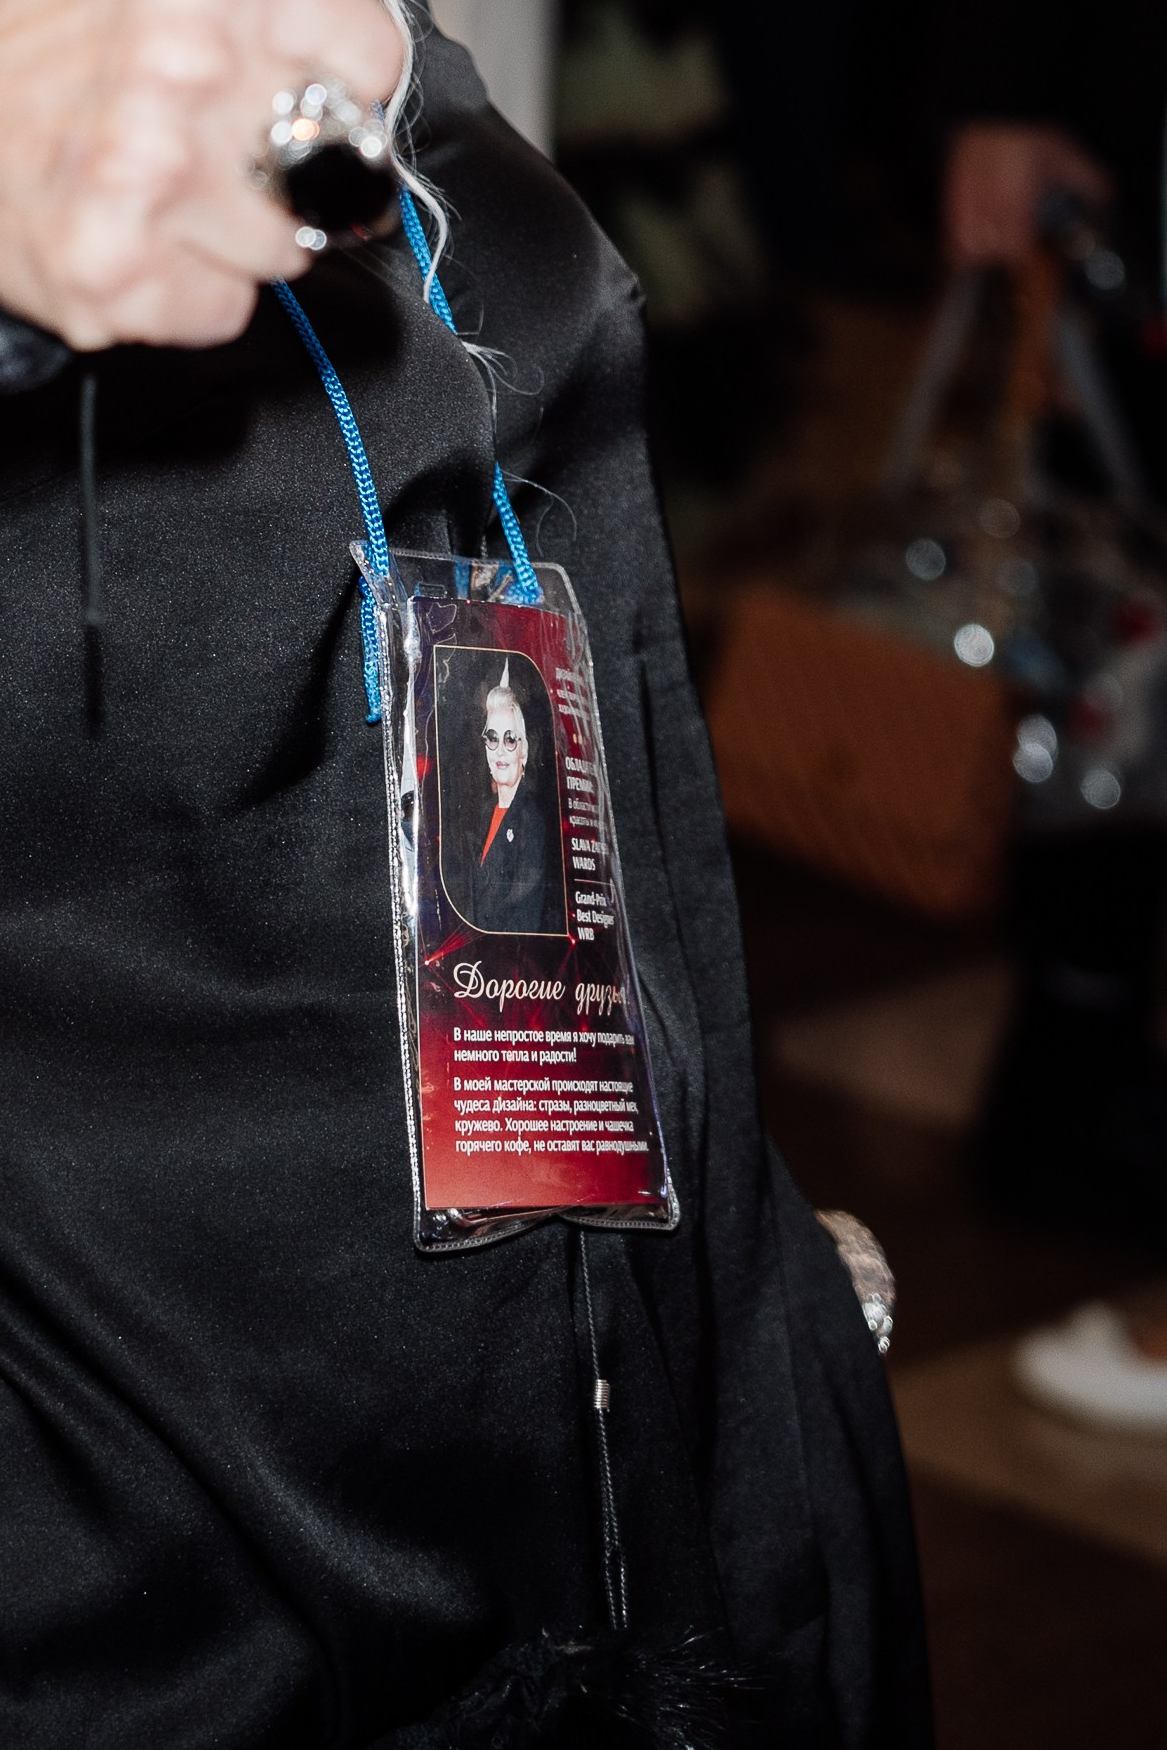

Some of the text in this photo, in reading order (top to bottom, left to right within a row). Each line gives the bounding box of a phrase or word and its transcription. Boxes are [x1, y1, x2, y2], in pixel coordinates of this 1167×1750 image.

[576, 909, 592, 923] Best
[577, 926, 595, 941] WRB
[453, 960, 566, 1013] Дорогие
[453, 1026, 462, 1042] В
[463, 1029, 493, 1042] наше
[494, 1029, 544, 1046] непростое
[545, 1030, 572, 1046] время
[572, 1031, 579, 1043] я
[579, 1031, 597, 1048] хочу
[454, 1046, 577, 1067] немного тепла и радости!
[453, 1076, 462, 1092] В
[463, 1076, 492, 1092] моей
[493, 1077, 551, 1096] мастерской
[551, 1080, 599, 1096] происходят
[453, 1099, 491, 1116] чудеса
[492, 1096, 537, 1114] дизайна:
[538, 1099, 572, 1116] стразы,
[573, 1098, 626, 1116] разноцветный
[454, 1119, 503, 1136] кружево.
[504, 1117, 549, 1136] Хорошее
[550, 1120, 598, 1136] настроение
[598, 1120, 605, 1132] и
[455, 1140, 503, 1157] горячего
[503, 1136, 532, 1156] кофе,
[533, 1140, 546, 1152] не
[546, 1140, 581, 1152] оставят
[581, 1140, 595, 1152] вас
